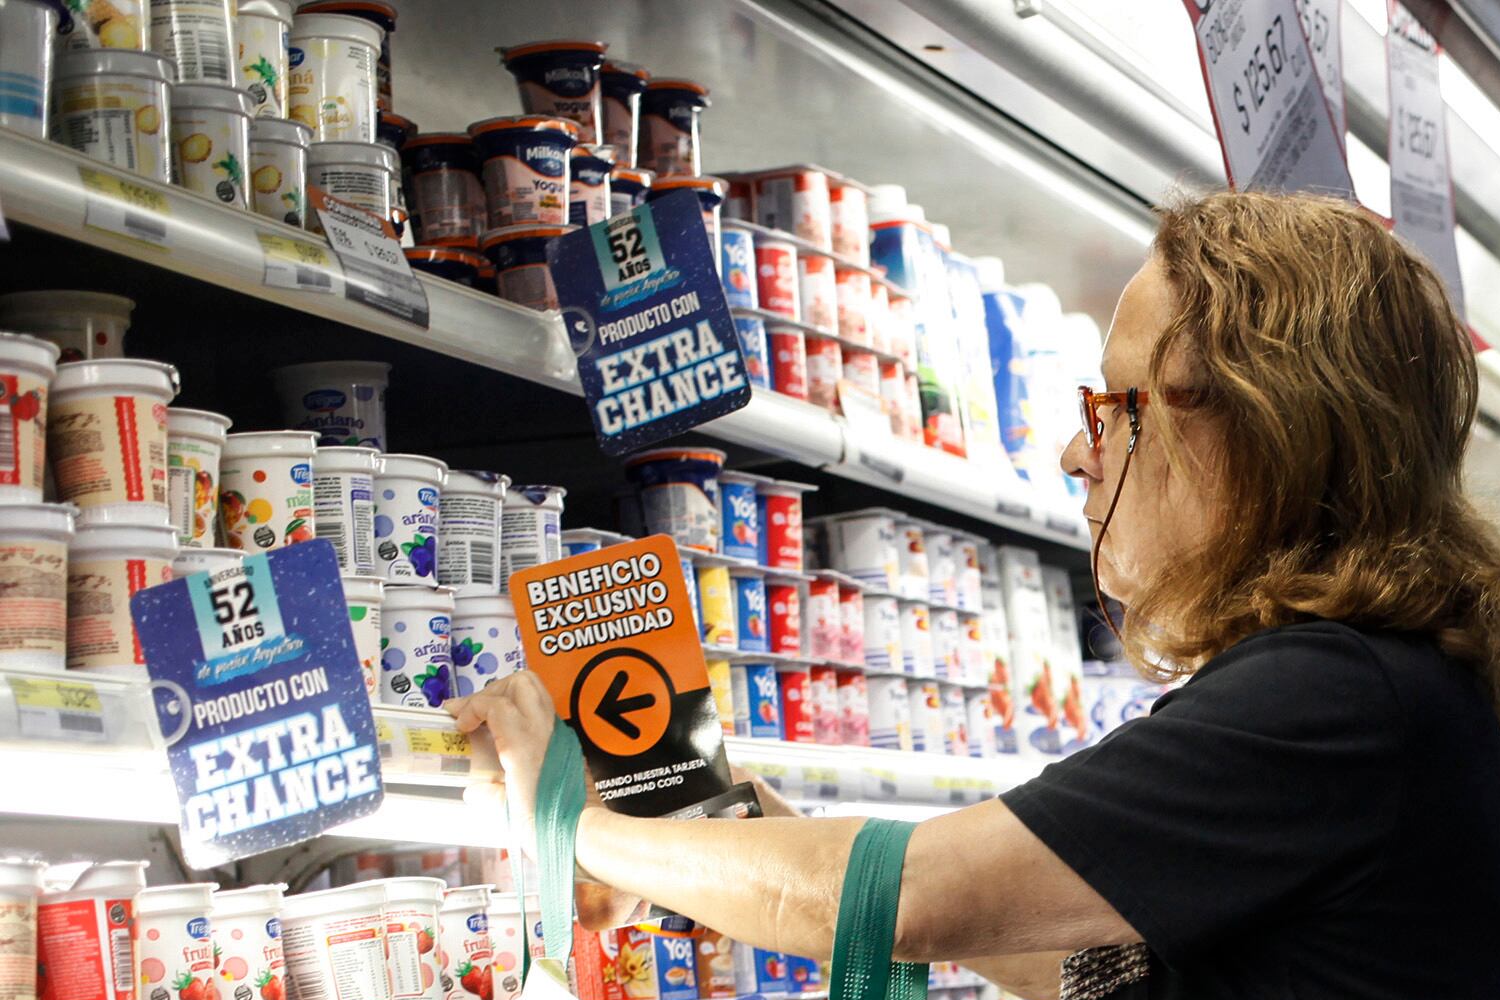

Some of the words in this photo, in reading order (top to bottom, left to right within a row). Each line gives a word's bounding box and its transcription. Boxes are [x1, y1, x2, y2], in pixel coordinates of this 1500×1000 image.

[607, 226, 647, 264] 52
[617, 257, 652, 283] AÑOS
[598, 302, 671, 346] PRODUCTO
[669, 290, 701, 319] CON
[595, 319, 724, 396] EXTRA
[596, 350, 748, 436] CHANCE
[209, 580, 260, 626] 52
[525, 551, 663, 608] BENEFICIO
[532, 579, 669, 633] EXCLUSIVO
[221, 621, 266, 650] AÑOS
[538, 605, 675, 657] COMUNIDAD
[193, 680, 289, 730] PRODUCTO
[290, 665, 330, 700] CON
[188, 702, 357, 793] EXTRA
[633, 765, 672, 786] NUESTRA
[671, 757, 708, 776] TARJETA
[184, 744, 382, 846] CHANCE
[599, 781, 657, 803] COMUNIDAD
[656, 774, 685, 792] COTO
